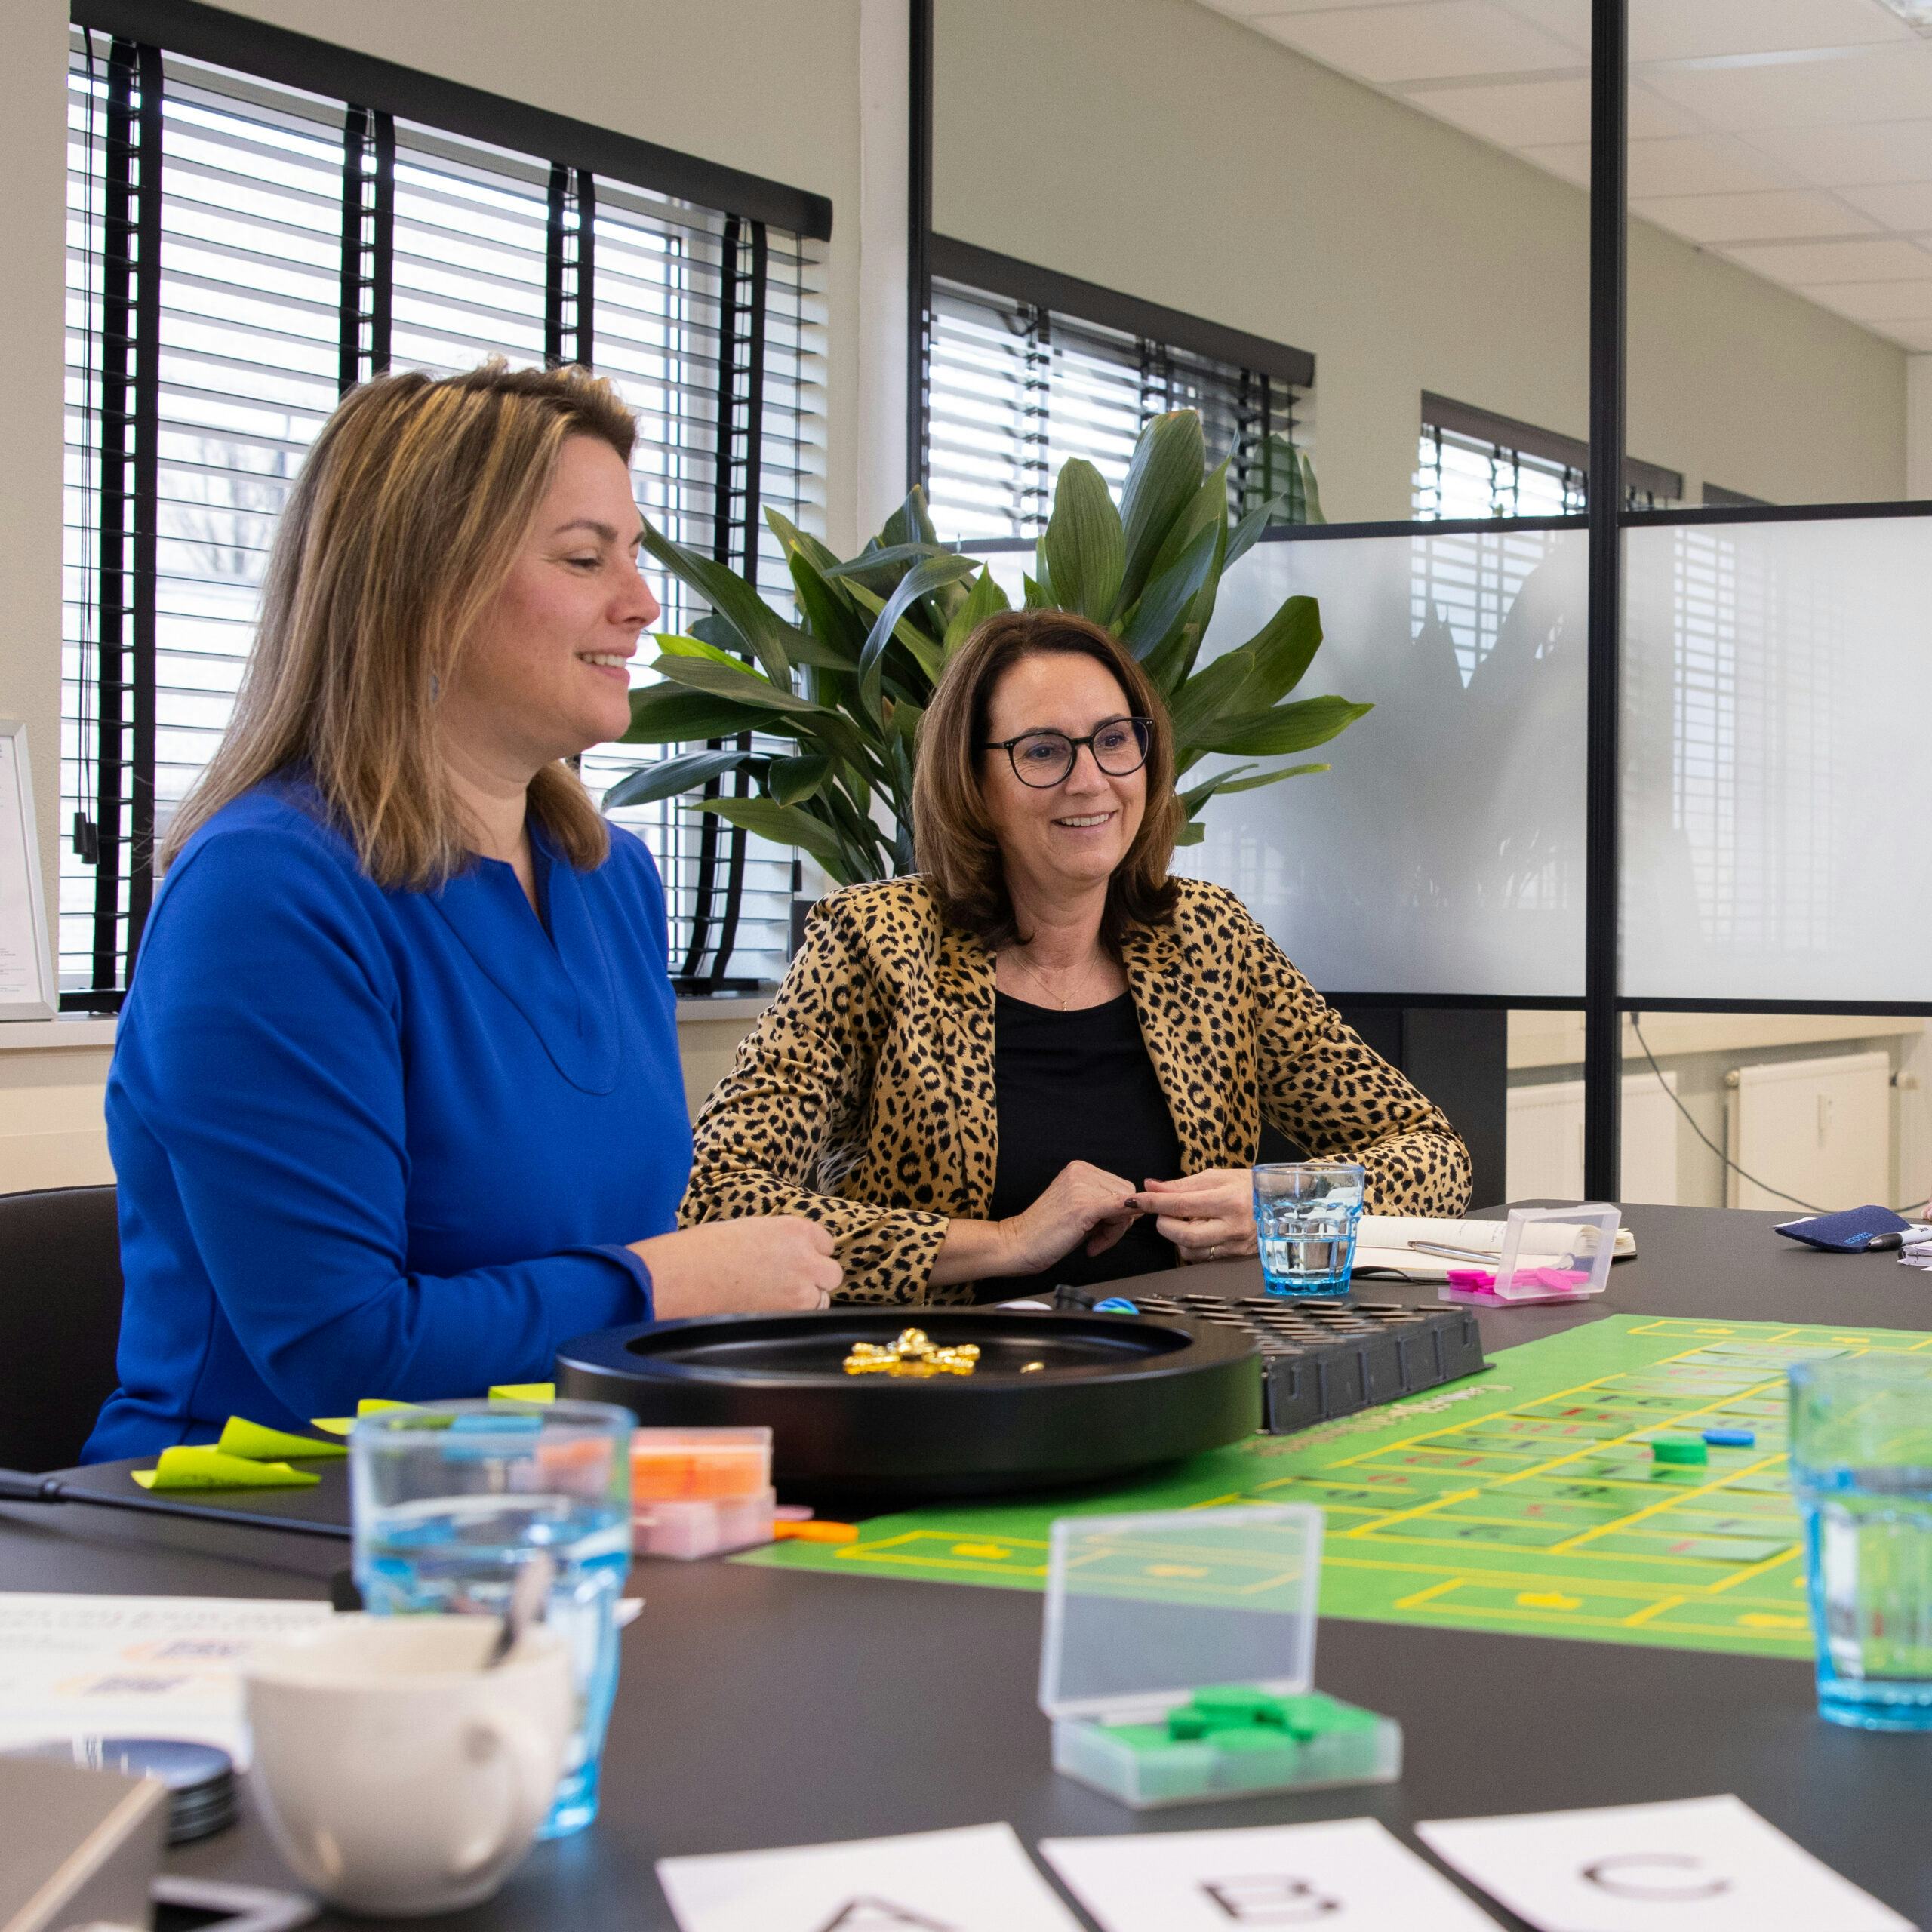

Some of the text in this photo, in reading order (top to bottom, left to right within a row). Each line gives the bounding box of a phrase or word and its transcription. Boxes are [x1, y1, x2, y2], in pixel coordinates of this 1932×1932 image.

[1195, 1874, 1345, 1926] B
[1577, 1853, 1733, 1901] C
[814, 1894, 958, 1932] A
